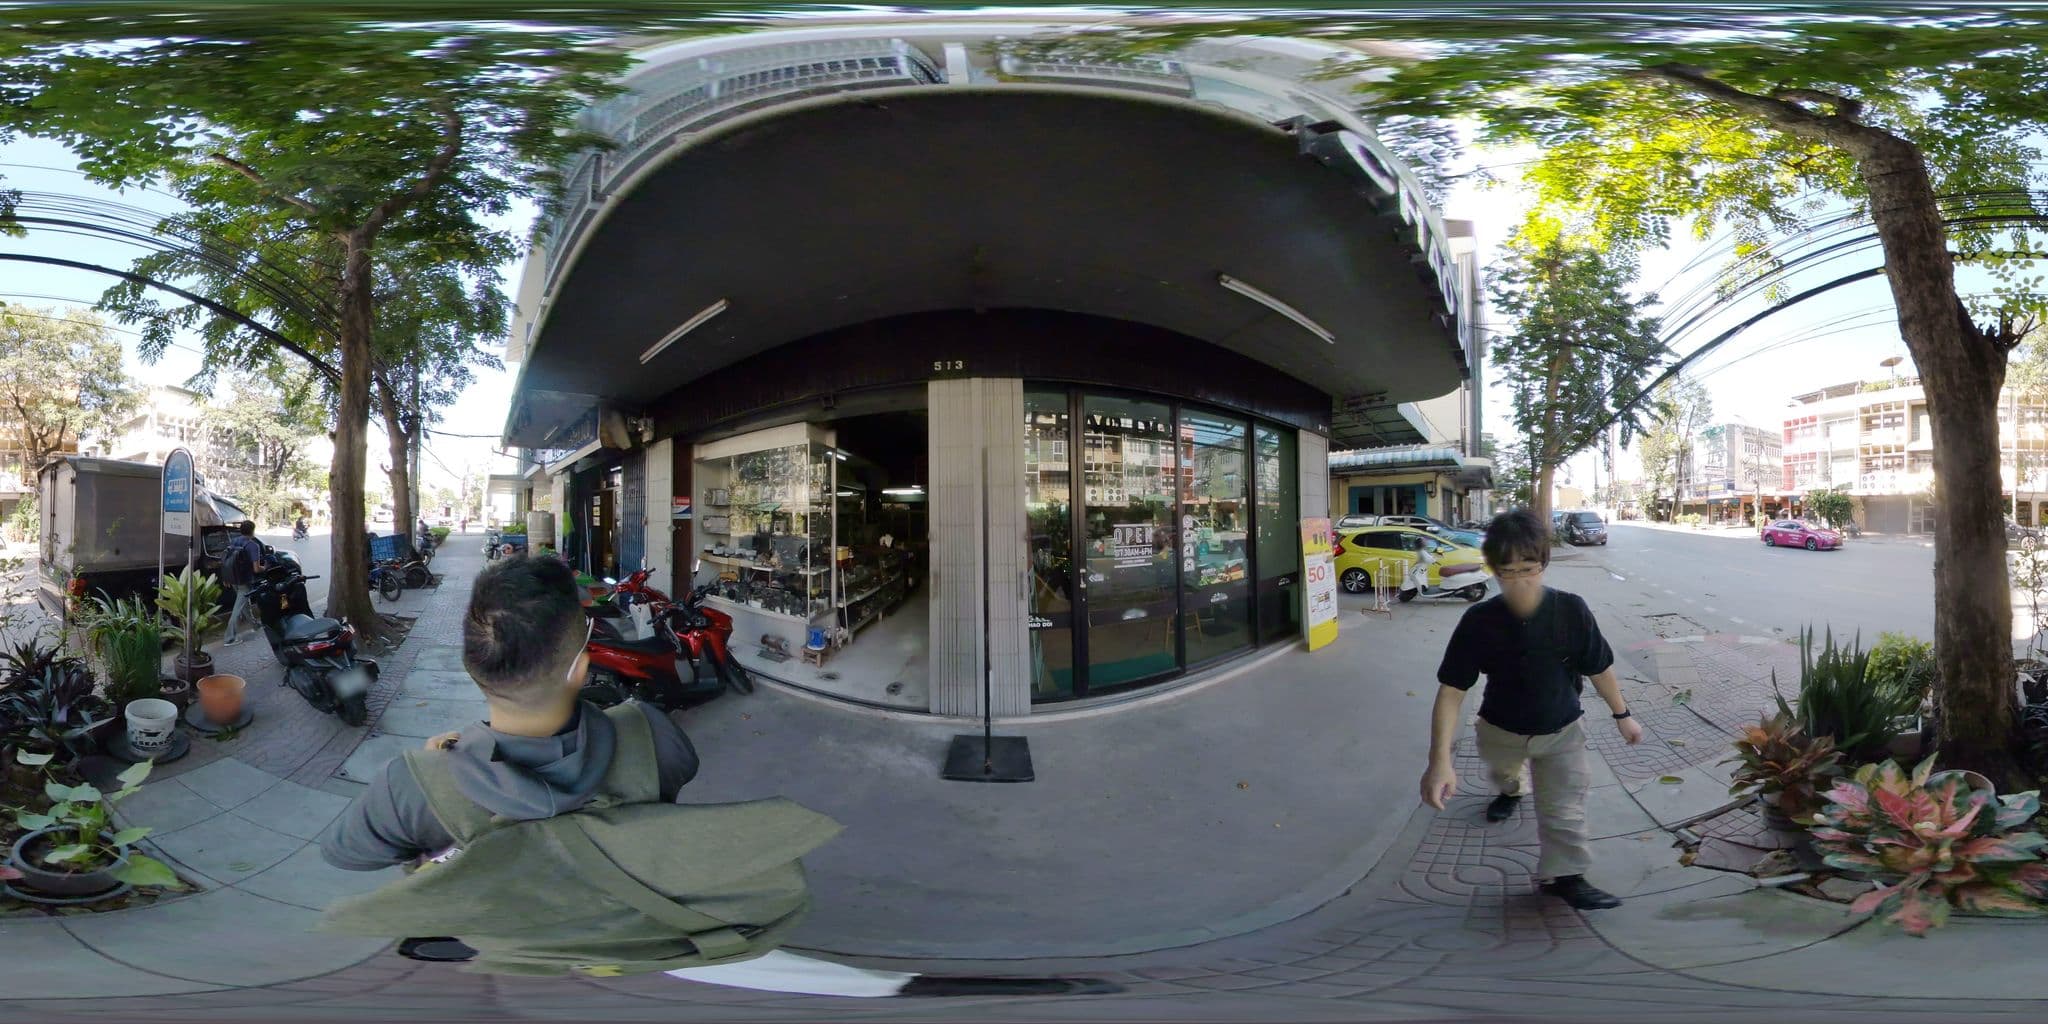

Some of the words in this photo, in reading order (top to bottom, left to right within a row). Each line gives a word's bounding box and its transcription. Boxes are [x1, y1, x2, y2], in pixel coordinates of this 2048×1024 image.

[934, 360, 963, 371] 513
[1113, 527, 1153, 545] OPEN
[1308, 565, 1326, 584] 50
